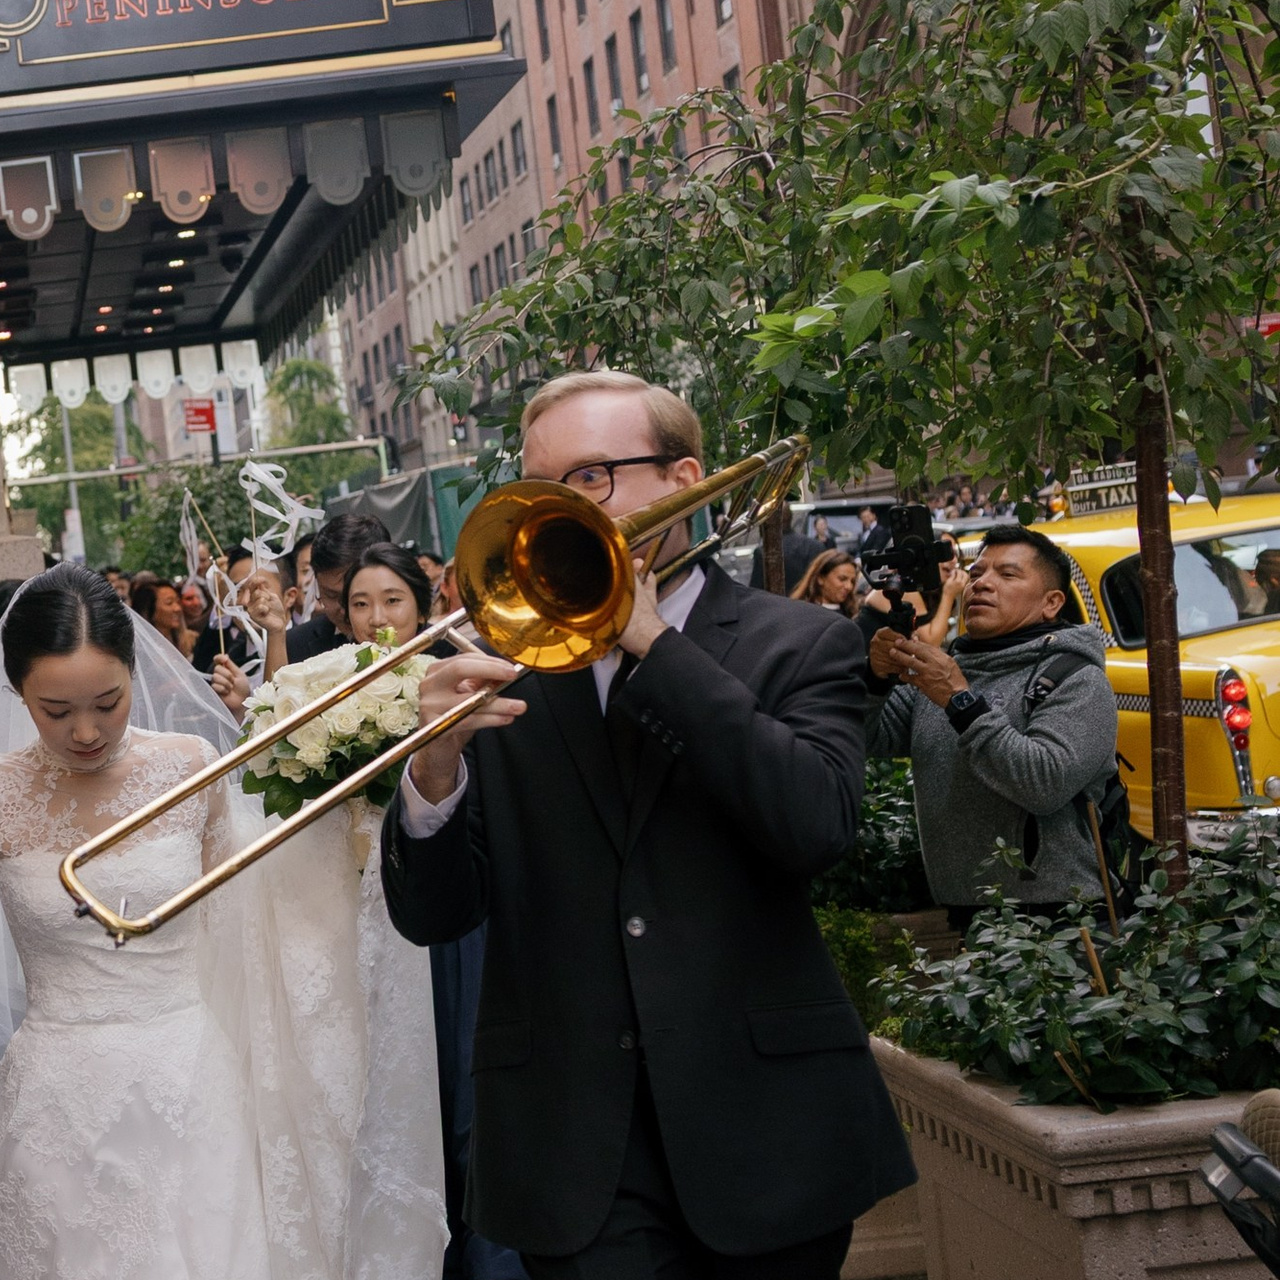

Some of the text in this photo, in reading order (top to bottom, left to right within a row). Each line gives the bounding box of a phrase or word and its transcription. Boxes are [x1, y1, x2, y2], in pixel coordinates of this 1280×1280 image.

[1077, 474, 1089, 484] ON
[1093, 468, 1121, 481] RADIO
[1073, 490, 1090, 500] OFF
[1097, 484, 1137, 507] TAXI
[1073, 501, 1096, 512] DUTY
